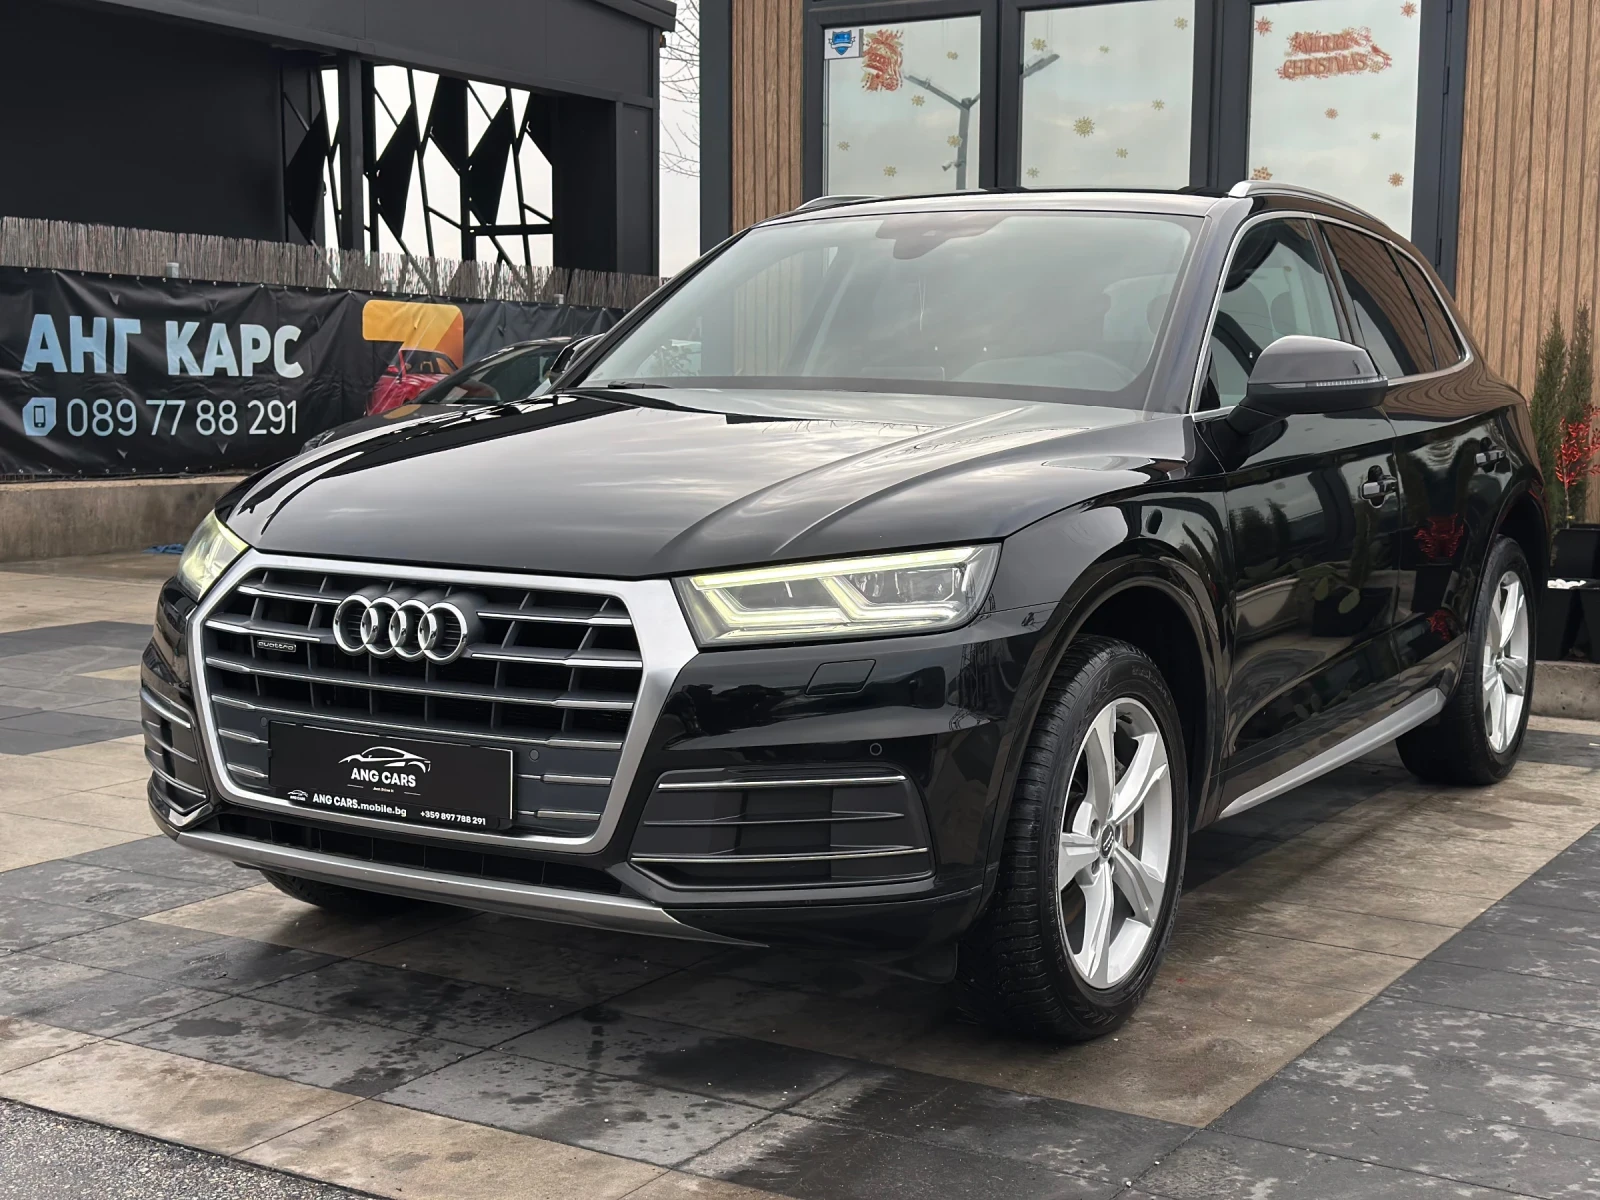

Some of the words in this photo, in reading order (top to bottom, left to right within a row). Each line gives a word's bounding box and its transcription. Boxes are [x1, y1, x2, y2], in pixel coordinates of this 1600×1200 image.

[1283, 52, 1369, 79] CHRISTMAS
[21, 313, 142, 375] АНГ
[165, 320, 304, 379] КАРС
[67, 398, 138, 437] 089
[146, 400, 186, 436] 77
[195, 400, 238, 436] 88
[247, 400, 298, 435] 291
[350, 767, 380, 783] ANG
[381, 771, 417, 788] CARS
[312, 793, 333, 805] ANG
[333, 796, 407, 817] CARS.mobile.bg
[420, 810, 440, 819] +359
[440, 812, 456, 822] 897
[456, 814, 472, 824] 788
[472, 816, 486, 826] 291
